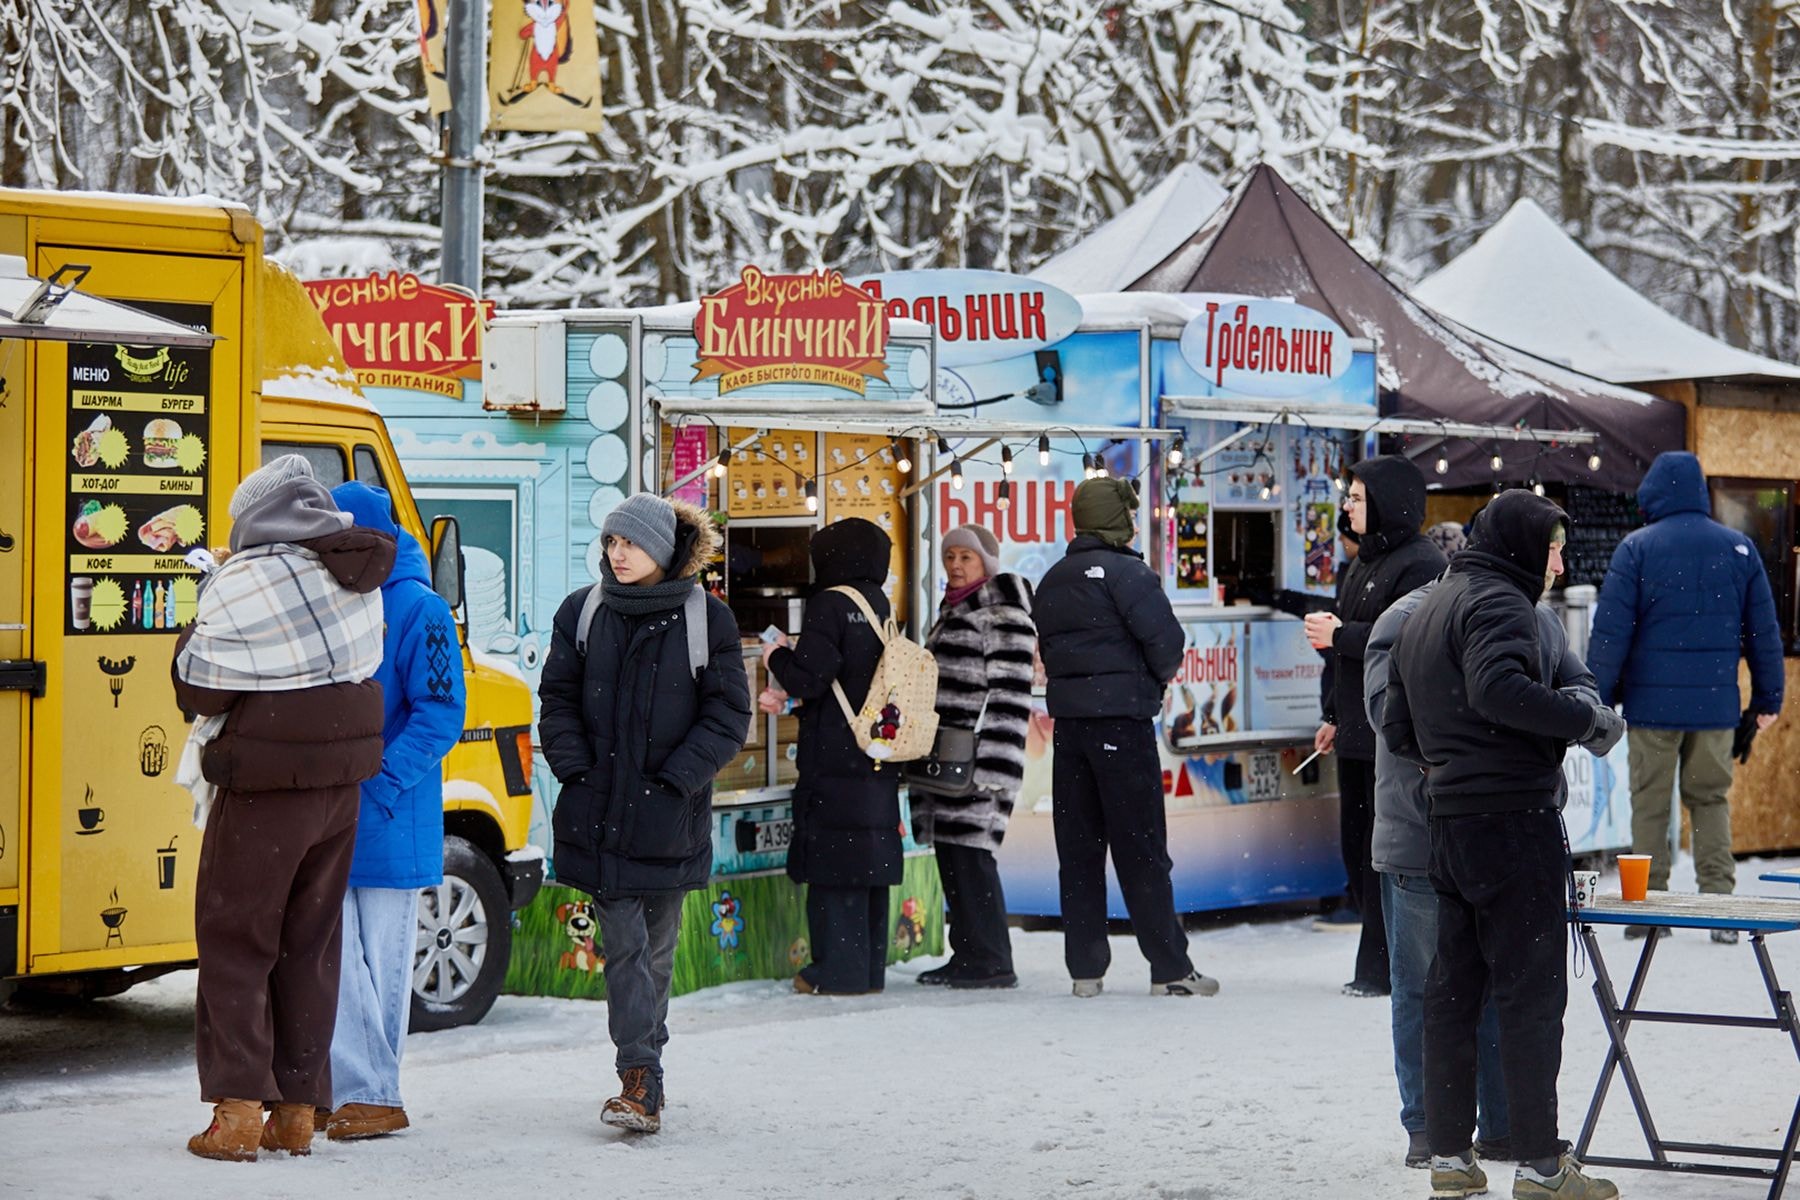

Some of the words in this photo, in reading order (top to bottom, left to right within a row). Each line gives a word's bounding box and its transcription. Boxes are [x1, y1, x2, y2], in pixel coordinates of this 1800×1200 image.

[743, 267, 844, 316] Вкусные
[860, 279, 1047, 342] льник
[1205, 302, 1334, 388] Трдельник
[72, 366, 111, 382] МЕНЮ
[164, 360, 189, 390] life
[357, 372, 376, 385] ГО
[381, 374, 455, 395] ПИТАНИЯ
[725, 372, 754, 391] КАФЕ
[756, 369, 811, 381] БЫСТРОГО
[814, 370, 862, 389] ПИТАНИЯ
[81, 395, 122, 407] ШАУРМА
[161, 399, 194, 410] БУРГЕР
[81, 478, 119, 491] ХОТ-ДОГ
[160, 480, 193, 491] БЛИНЫ
[87, 558, 112, 569] КОФЕ
